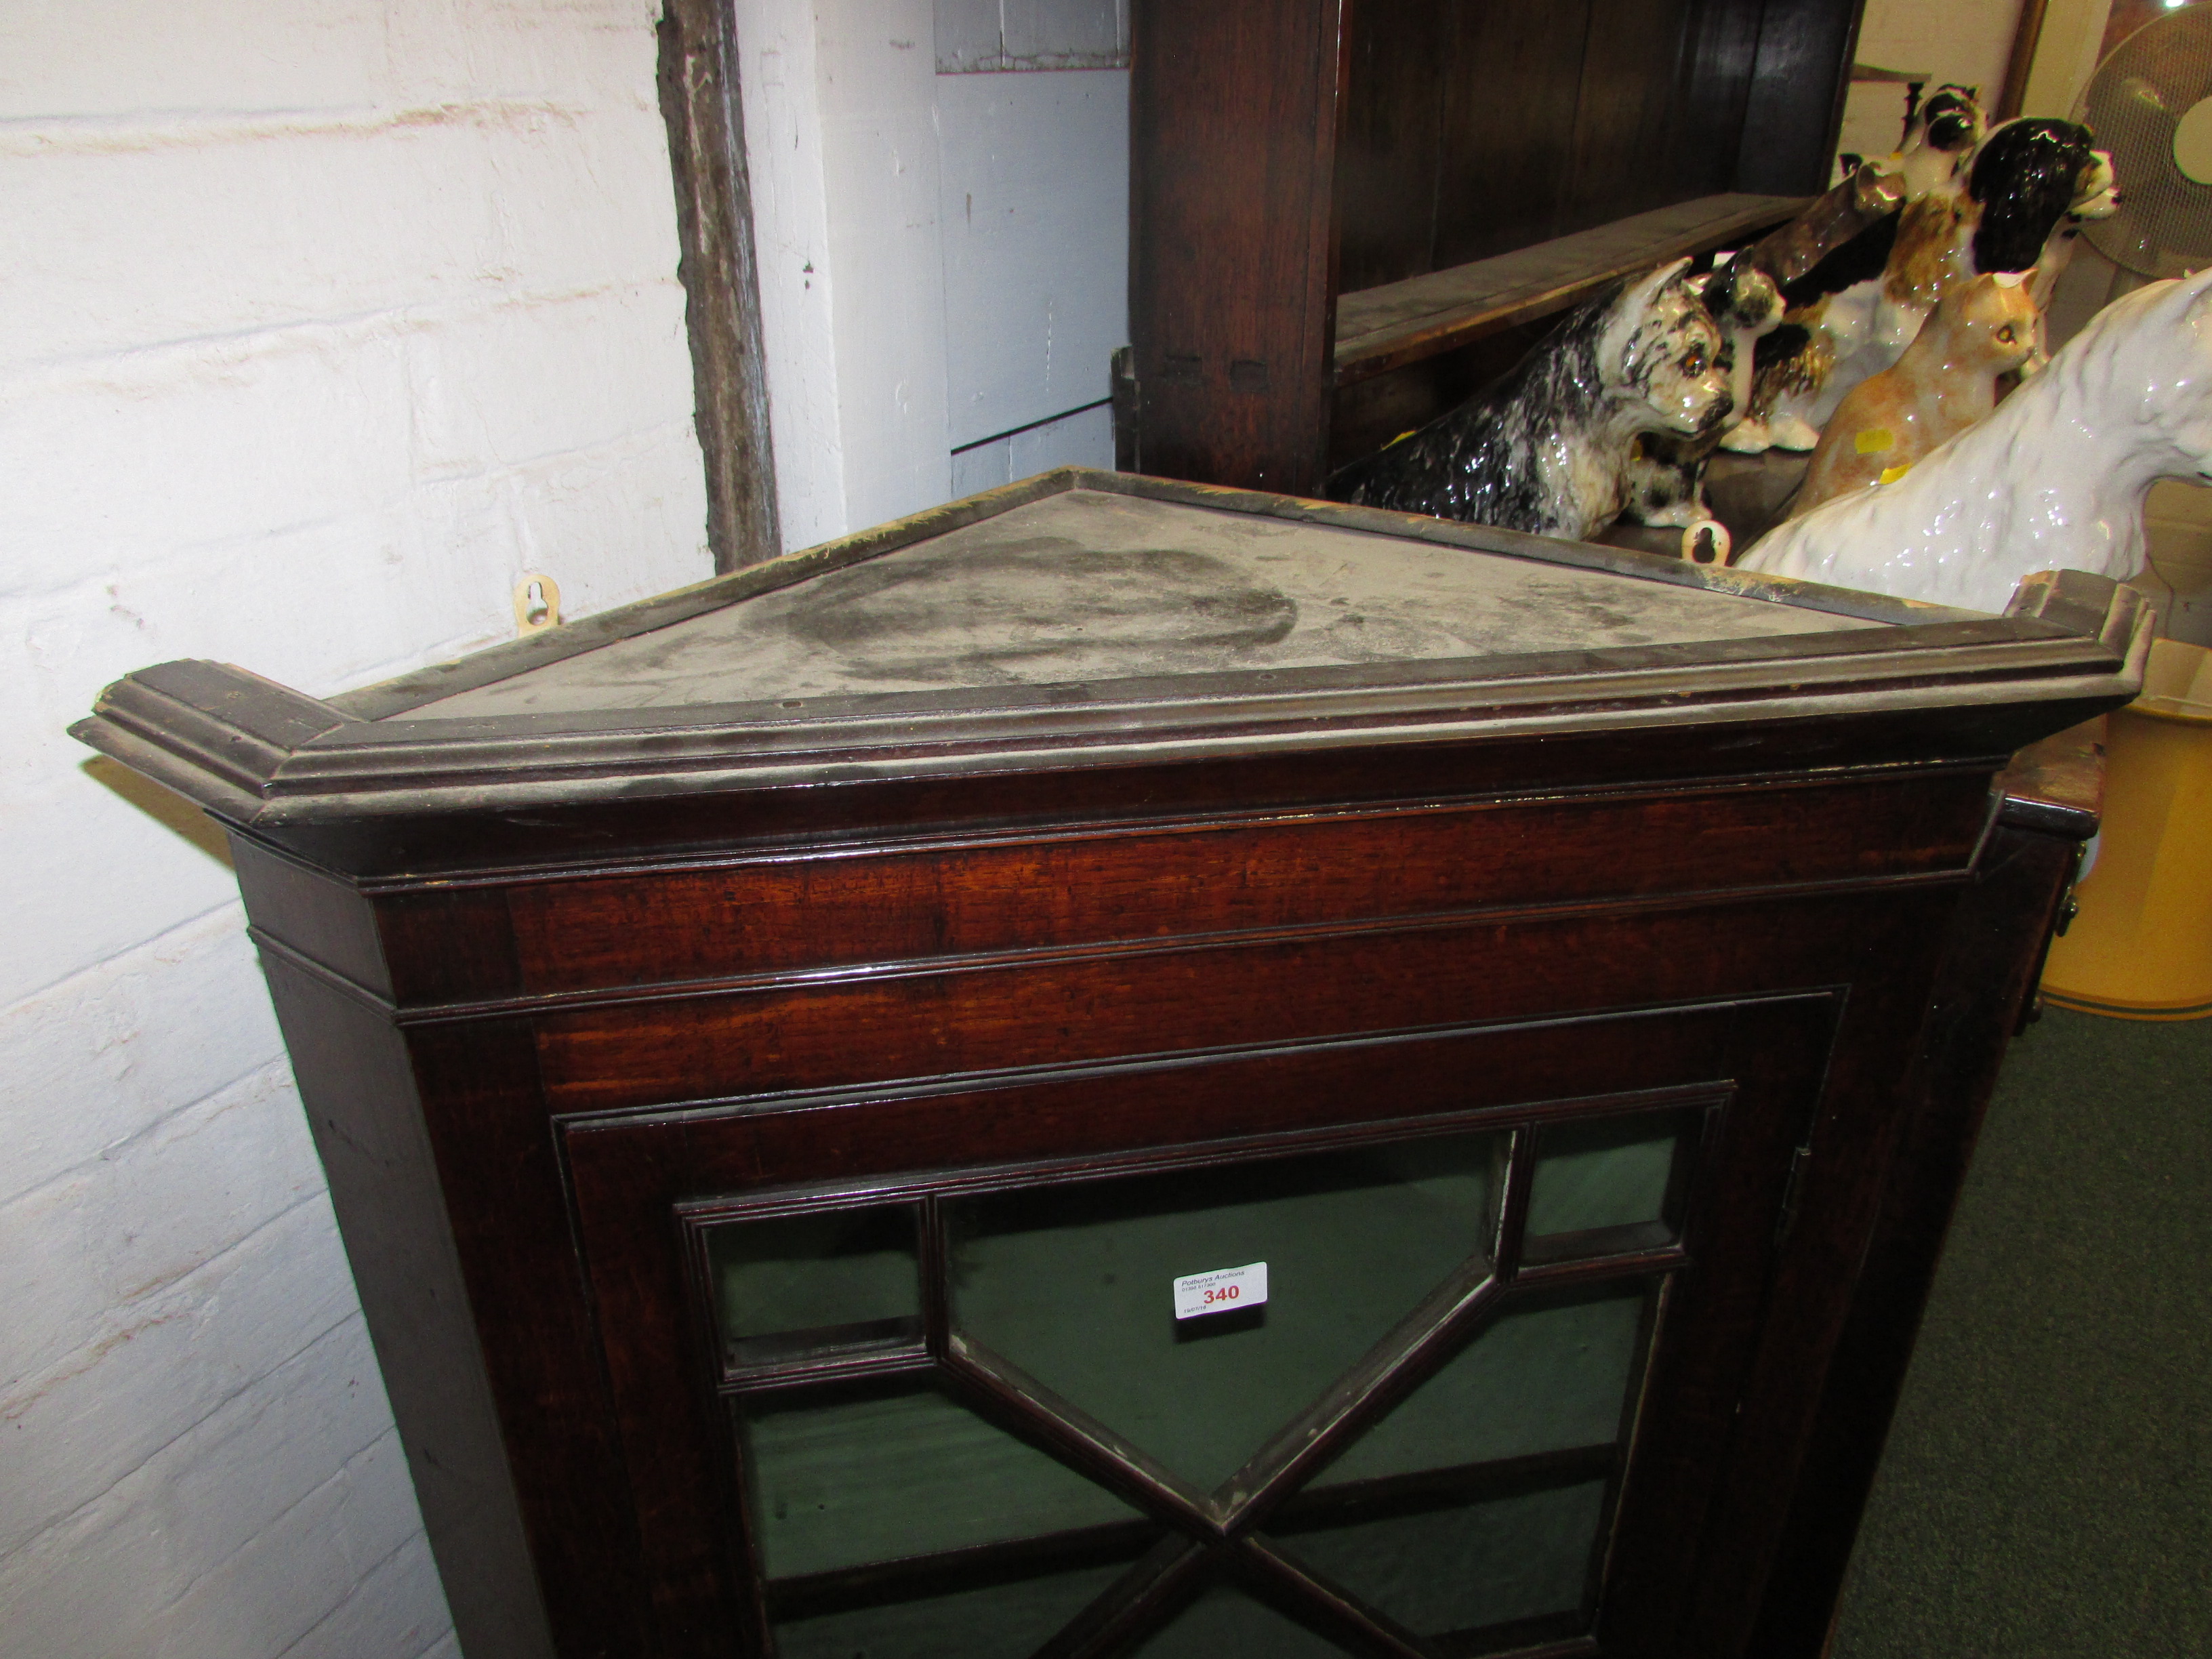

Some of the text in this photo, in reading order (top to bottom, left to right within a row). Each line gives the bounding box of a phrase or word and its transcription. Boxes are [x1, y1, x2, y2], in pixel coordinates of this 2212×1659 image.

[1182, 1271, 1245, 1286] Potburys Auctions
[1204, 1285, 1240, 1304] 340
